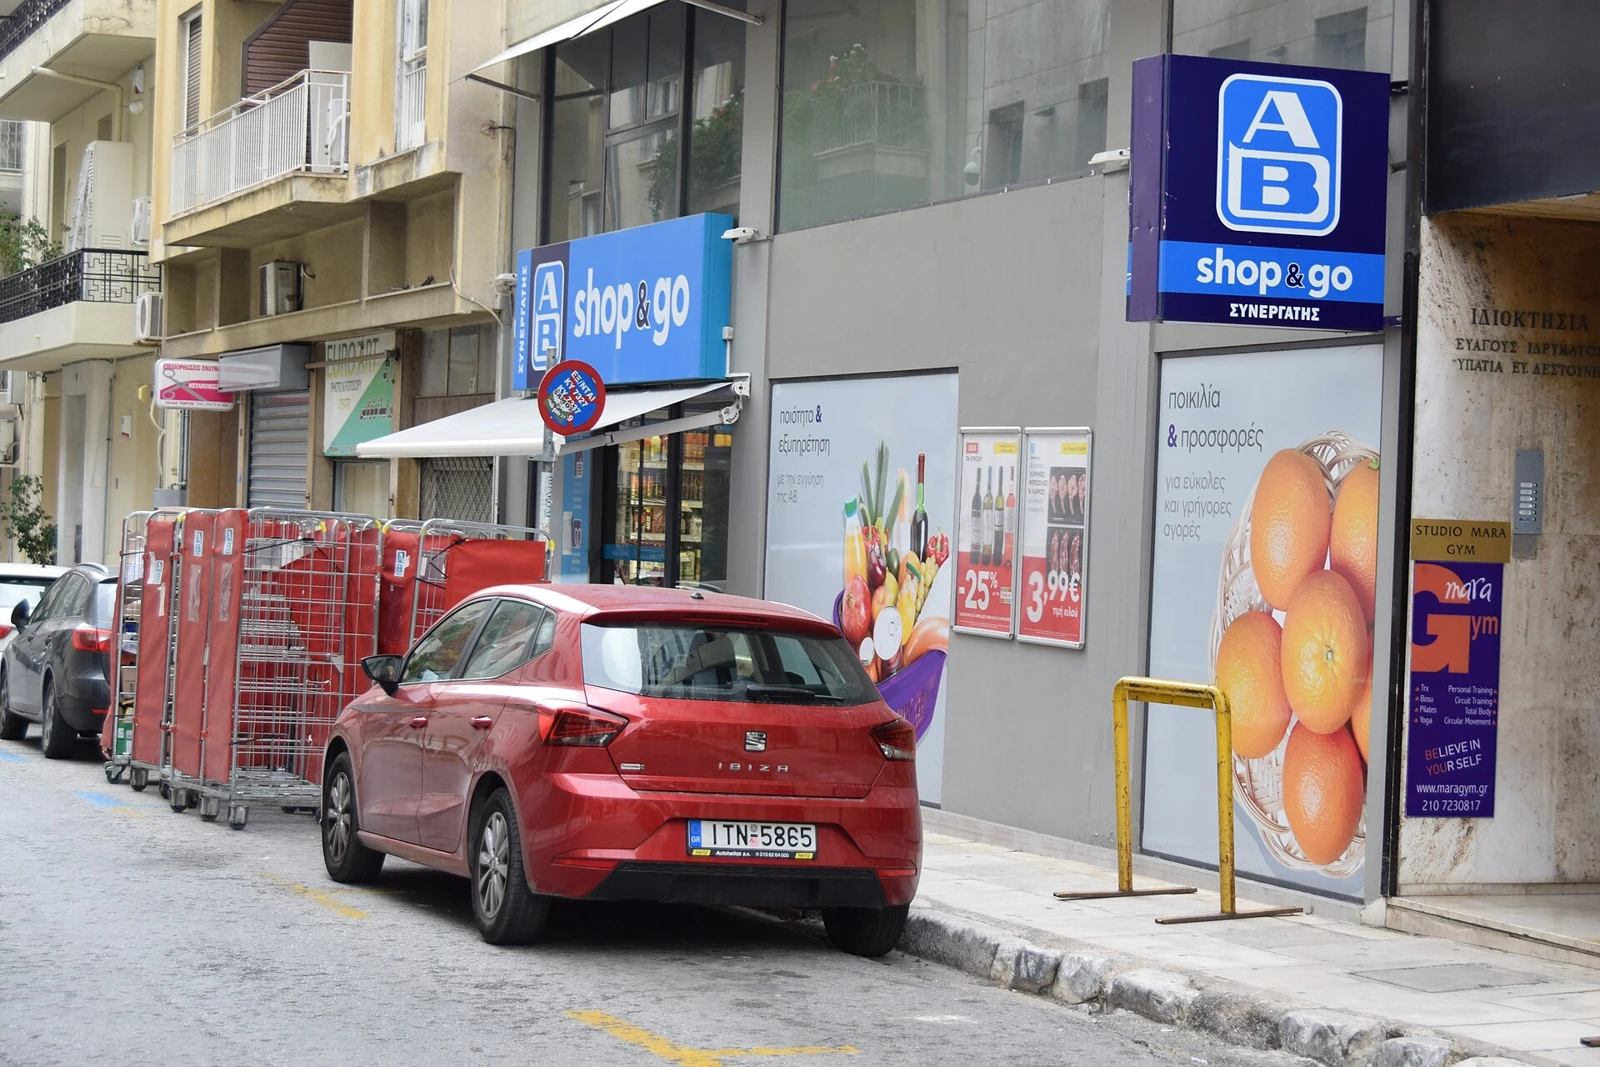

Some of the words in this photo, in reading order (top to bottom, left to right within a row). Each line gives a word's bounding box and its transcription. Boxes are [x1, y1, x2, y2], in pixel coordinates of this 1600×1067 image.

[517, 265, 528, 374] ΣΥΝΕΡΓΑΤΗΣ
[1229, 303, 1320, 322] ΣΥΝΕΡΓΑΤΗΣ
[1470, 308, 1589, 331] ΙΔΙΟΚΤΗΣΙΑ
[1455, 338, 1518, 353] ΕΥΑΓΟΥΣ
[573, 389, 589, 407] 7327
[1168, 383, 1221, 409] ποικιλία
[779, 404, 814, 428] ποιότητα
[815, 405, 822, 423] &
[778, 433, 831, 457] εξυπηρέτηση
[1167, 424, 1178, 448] &
[1180, 422, 1264, 454] προσφορές
[777, 474, 785, 487] με
[786, 473, 796, 487] την
[797, 471, 824, 489] εγγύηση
[1165, 476, 1181, 493] για
[1183, 471, 1226, 492] εύκολες
[776, 491, 787, 506] της
[1164, 498, 1179, 513] και
[1182, 495, 1233, 518] γρήγορες
[1163, 519, 1201, 541] αγορές
[1415, 524, 1463, 537] STUDIO
[1471, 527, 1507, 539] MARA
[1446, 544, 1476, 556] GYM
[1026, 570, 1081, 623] 3,99€
[1444, 577, 1493, 602] mara
[1052, 606, 1063, 619] τιμή
[1064, 607, 1079, 618] κιλού
[1421, 684, 1429, 692] Trx
[1448, 685, 1471, 693] Personal
[1472, 686, 1493, 696] Training
[1420, 695, 1433, 703] Bosu
[1454, 697, 1471, 705] Circuit
[1472, 697, 1493, 707] Training
[1420, 705, 1437, 714] Pilates
[1465, 707, 1477, 715] Total
[1478, 708, 1492, 717] Body
[1420, 716, 1433, 725] Yoga
[1444, 716, 1464, 725] Circular
[1464, 718, 1491, 726] Movement
[1424, 741, 1468, 760] BELIEVE
[1469, 739, 1481, 751] IN
[718, 762, 789, 772] IBIZA
[1426, 760, 1455, 776] YOUR
[1456, 754, 1482, 770] SELF
[1416, 784, 1488, 797] www.maragym.gr
[1422, 799, 1440, 811] 210
[1442, 799, 1481, 811] 7230817
